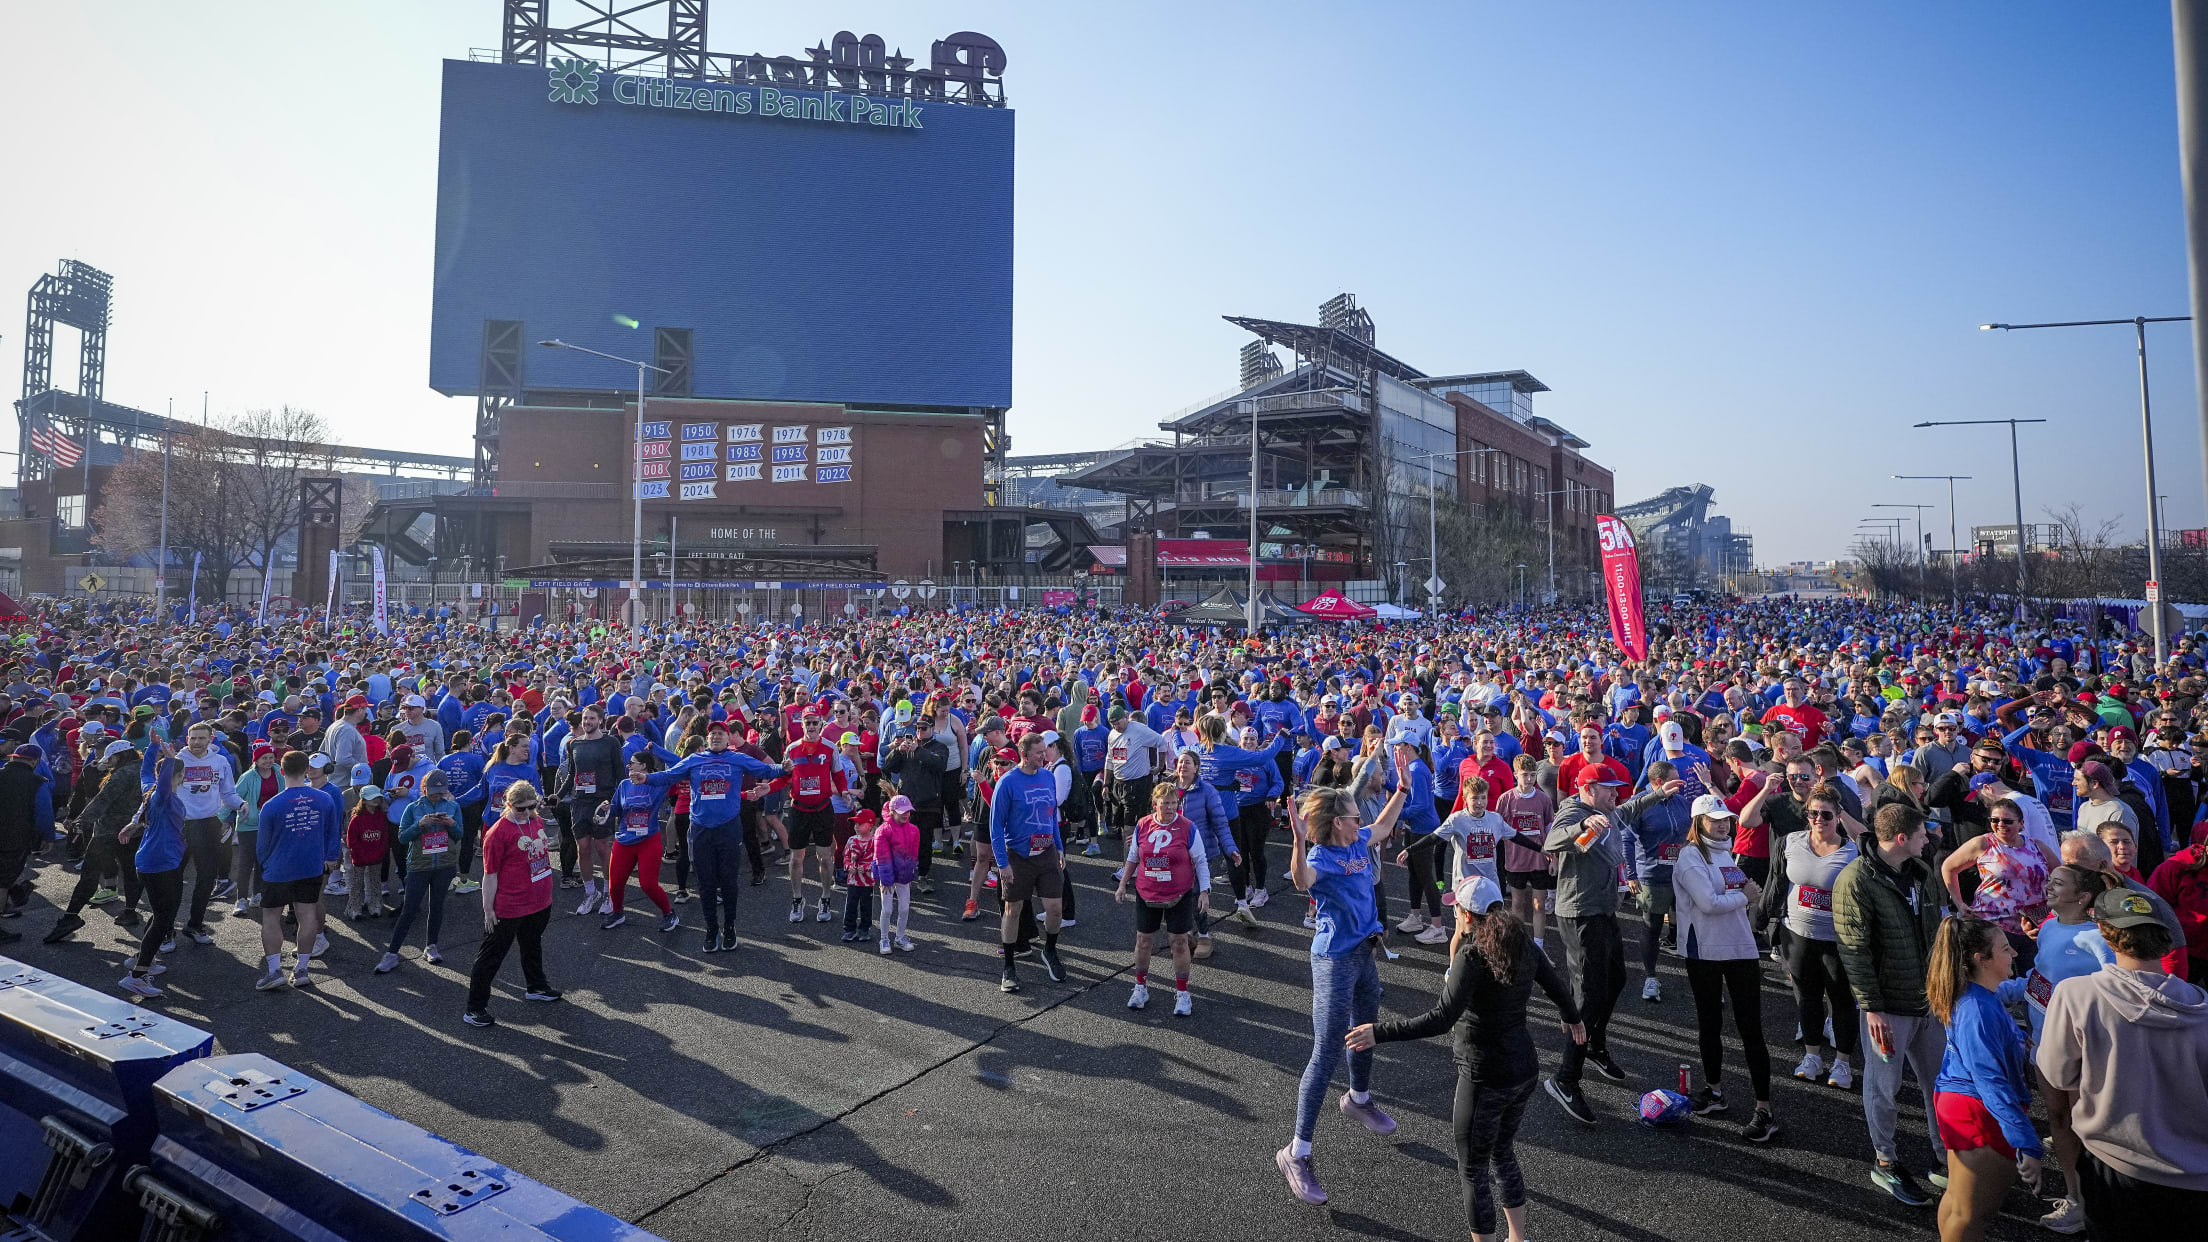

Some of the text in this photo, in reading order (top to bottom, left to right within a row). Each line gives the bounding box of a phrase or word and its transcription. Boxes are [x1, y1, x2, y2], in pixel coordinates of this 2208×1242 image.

[612, 75, 923, 128] Citizens Bank Park
[645, 424, 665, 436] 915
[685, 425, 711, 438] 1950
[731, 427, 757, 439] 1976
[776, 428, 801, 440] 1977
[821, 429, 846, 441] 1978
[643, 443, 664, 456] 980
[685, 445, 709, 457] 1981
[731, 446, 756, 459] 1983
[775, 447, 801, 459] 1993
[820, 448, 845, 460] 2007
[643, 463, 663, 476] 008
[683, 464, 710, 477] 2009
[730, 465, 756, 478] 2010
[776, 467, 800, 479] 2011
[819, 467, 845, 480] 2022
[643, 483, 663, 495] 023
[683, 484, 709, 497] 2024
[711, 527, 776, 539] HOME OF THE
[1597, 519, 1634, 551] 5K
[1615, 563, 1629, 620] 11:00-13:00
[1623, 623, 1633, 647] MILE
[1185, 617, 1227, 626] Physical Therapy
[1014, 721, 1036, 731] TEMPLE
[1671, 733, 1677, 741] P
[818, 753, 826, 765] P
[1148, 829, 1172, 854] P
[1802, 890, 1830, 907] 2785
